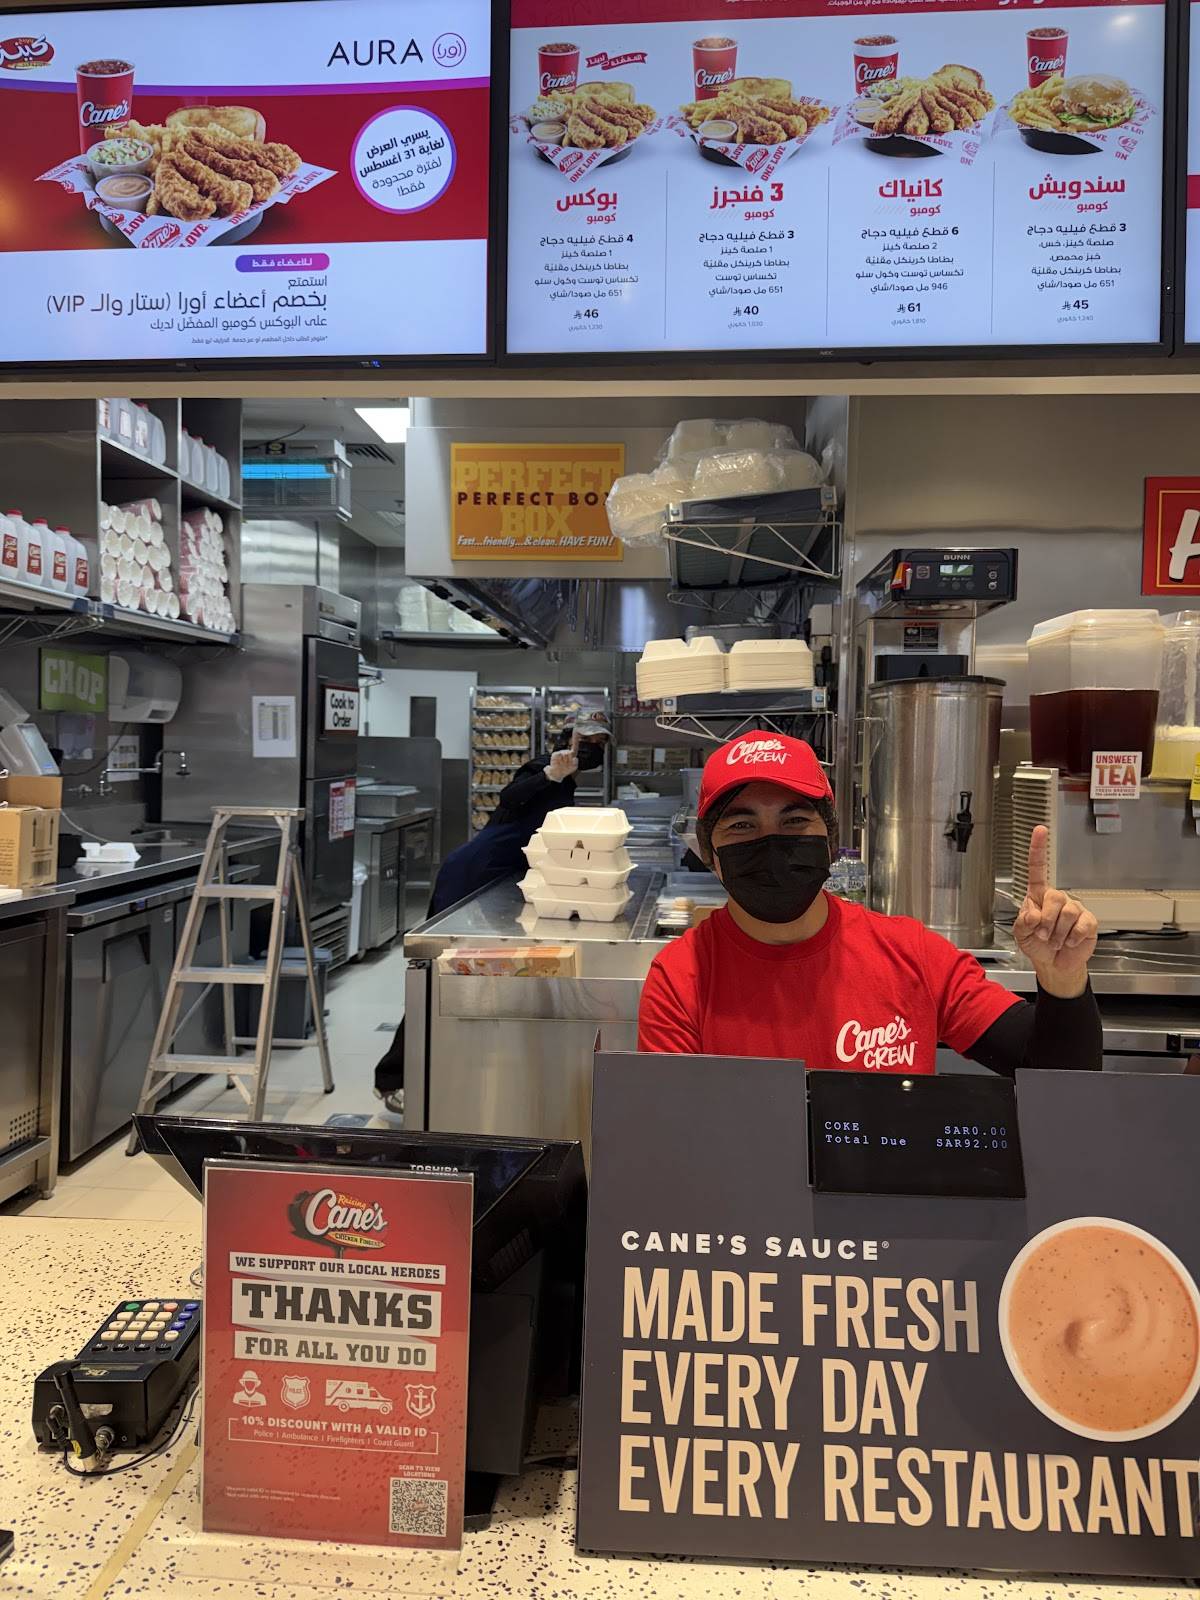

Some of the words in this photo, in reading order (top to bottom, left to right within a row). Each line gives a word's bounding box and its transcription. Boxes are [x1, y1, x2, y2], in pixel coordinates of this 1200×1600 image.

[328, 40, 424, 67] AURA
[1028, 55, 1064, 73] Cane's
[695, 67, 734, 88] Cane's
[856, 61, 895, 83] Cane's
[540, 71, 577, 90] Cane's
[81, 100, 129, 127] Cane's
[401, 129, 430, 147] يسري
[366, 137, 398, 159] العرض
[418, 137, 445, 155] لغاية
[404, 148, 416, 160] 31
[416, 156, 442, 175] لفترة
[372, 169, 414, 189] محدودة
[769, 182, 784, 201] 3
[879, 178, 943, 202] كانياك
[1029, 173, 1125, 201] سندويش
[556, 188, 618, 212] بوكس
[710, 184, 764, 210] فنجرز
[909, 203, 941, 217] كومبو
[1076, 199, 1108, 213] كومبو
[586, 212, 617, 225] كومبو
[744, 208, 775, 221] كومبو
[889, 227, 920, 239] فيليه
[921, 226, 949, 238] قطع
[951, 226, 959, 236] 6
[1027, 225, 1053, 236] دجاج
[1056, 224, 1086, 236] فيليه
[1089, 223, 1117, 234] قطع
[1119, 223, 1127, 232] 3
[598, 234, 624, 246] قطع
[626, 234, 634, 243] 4
[698, 232, 724, 243] دجاج
[726, 231, 756, 243] فيليه
[758, 230, 785, 242] قطع
[787, 230, 795, 239] 3
[861, 229, 887, 240] دجاج
[540, 236, 565, 248] دجاج
[566, 235, 596, 247] فيليه
[882, 242, 901, 252] كينز
[902, 242, 930, 250] صلصة
[931, 242, 938, 250] 2
[1086, 239, 1114, 247] صلصة
[560, 250, 579, 259] كينز
[580, 249, 607, 257] صلصة
[720, 246, 739, 256] كينز
[740, 245, 768, 254] صلصة
[252, 258, 275, 268] فقط
[893, 255, 926, 265] كرينكل
[927, 255, 954, 264] بطاطا
[1085, 252, 1101, 262] خبز
[571, 263, 602, 272] كرينكل
[603, 263, 629, 272] بطاطا
[730, 259, 762, 269] كرينكل
[763, 259, 790, 268] بطاطا
[855, 271, 874, 280] سلو
[875, 271, 899, 280] وكول
[900, 269, 928, 278] توست
[929, 269, 964, 278] تكساس
[1060, 266, 1093, 276] كرينكل
[1094, 266, 1121, 275] بطاطا
[287, 275, 328, 290] استمتع
[534, 277, 552, 287] سلو
[553, 277, 577, 286] وكول
[577, 276, 604, 285] توست
[605, 275, 639, 284] تكساس
[715, 273, 741, 282] توست
[743, 272, 777, 282] تكساس
[753, 287, 767, 295] مل
[768, 286, 783, 294] 651
[870, 283, 914, 295] صودا/شاي
[915, 283, 929, 292] مل
[931, 283, 948, 291] 946
[1037, 281, 1082, 292] صودا/شاي
[1083, 281, 1098, 289] مل
[549, 289, 592, 301] صودا/شاي
[593, 290, 607, 299] مل
[608, 289, 623, 297] 651
[708, 286, 752, 298] صودا/شاي
[47, 294, 85, 315] VIP)
[128, 292, 171, 316] (ستار
[178, 291, 207, 315] أورا
[213, 289, 266, 310] أعضاء
[272, 289, 327, 313] بخصم
[1072, 299, 1089, 310] 45
[743, 305, 759, 315] 40
[907, 302, 921, 312] 61
[583, 309, 599, 319] 46
[150, 318, 174, 332] لديك
[221, 317, 257, 331] كومبو
[259, 315, 301, 330] البوكس
[304, 315, 328, 328] على
[455, 461, 619, 494] PERFECT
[457, 491, 555, 506] PERFECT
[501, 505, 575, 537] BOX
[559, 535, 586, 547] HAVE
[587, 535, 615, 547] FUN!
[44, 657, 105, 705] CHOP
[330, 693, 346, 710] Cook
[346, 695, 355, 710] to
[332, 711, 353, 728] Order
[725, 739, 786, 766] Cane's
[743, 751, 788, 766] CREW
[1096, 754, 1137, 764] UNSWEET
[1095, 764, 1137, 786] TEA
[835, 1015, 912, 1063] Cane's
[863, 1041, 916, 1070] CREW
[824, 1121, 860, 1132] COKE
[944, 1126, 1007, 1137] SAR0.00
[825, 1135, 870, 1146] Total
[880, 1136, 907, 1146] Due
[936, 1138, 1009, 1149] SAR92.00
[305, 1188, 389, 1236] Cane's
[620, 1229, 748, 1257] CANE'S
[234, 1256, 256, 1268] WE
[259, 1257, 316, 1273] SUPPORT
[319, 1262, 345, 1274] OUR
[347, 1263, 388, 1277] LOCAL
[390, 1266, 441, 1279] HEROES
[241, 1282, 433, 1330] THANKS
[622, 1265, 780, 1346] MADE
[800, 1272, 982, 1354] FRESH
[244, 1336, 289, 1357] FOR
[295, 1340, 339, 1361] ALL
[345, 1343, 391, 1364] YOU
[396, 1347, 428, 1367] DO
[619, 1349, 800, 1432] EVERY
[820, 1357, 929, 1438] DAY
[241, 1415, 265, 1426] 10%
[267, 1417, 328, 1431] DISCOUNT
[331, 1421, 362, 1434] WITH
[365, 1424, 373, 1434] A
[376, 1425, 412, 1437] VALID
[414, 1427, 428, 1438] ID
[253, 1429, 274, 1439] Police
[281, 1431, 319, 1442] Ambulance
[326, 1435, 365, 1446] Firefighters
[373, 1438, 393, 1447] Coast
[618, 1435, 800, 1519] EVERY
[822, 1443, 1200, 1538] RESTAURANT
